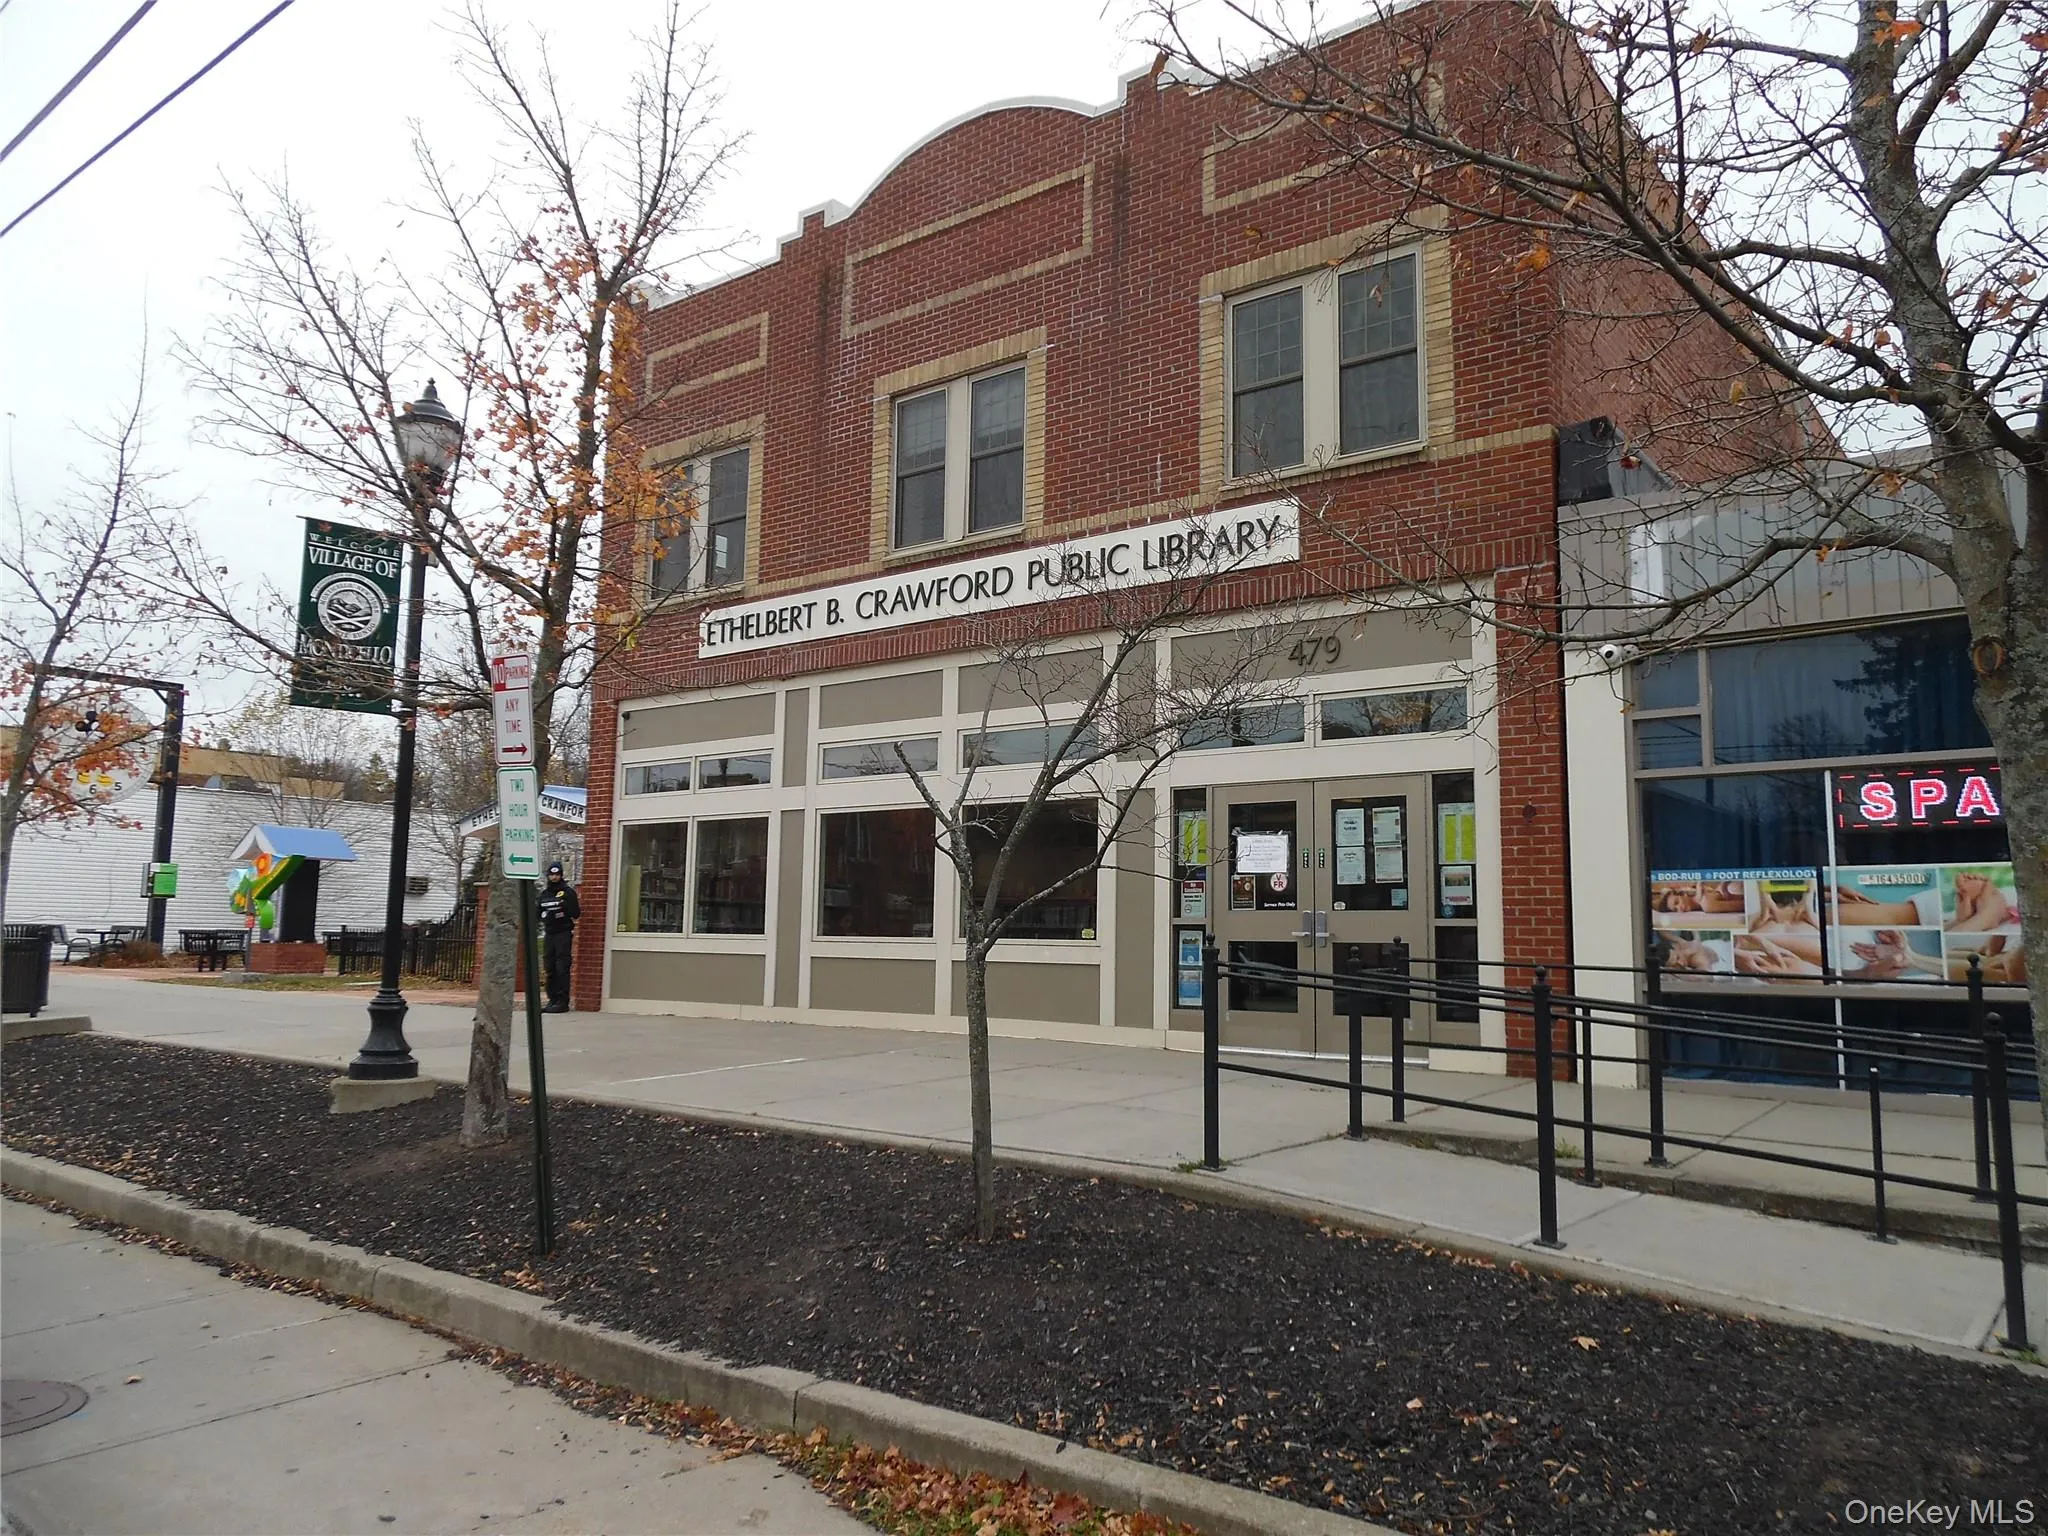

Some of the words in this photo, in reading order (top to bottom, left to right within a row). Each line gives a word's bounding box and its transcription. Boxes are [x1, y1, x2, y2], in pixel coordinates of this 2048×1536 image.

[309, 532, 400, 557] WELCOME
[308, 547, 373, 572] VILLAGE
[375, 560, 398, 578] OF
[706, 600, 818, 646] ETHELBERT
[826, 597, 845, 626] B.
[856, 565, 1014, 620] CRAWFORD
[1027, 543, 1130, 590] PUBLIC
[1142, 514, 1281, 571] LIBRARY
[1288, 636, 1341, 666] 479
[493, 664, 505, 684] NO
[504, 665, 529, 679] PARKING
[504, 698, 519, 712] ANY
[505, 720, 522, 733] TIME
[89, 785, 97, 795] 6
[114, 782, 122, 791] 5
[510, 779, 525, 793] TWO
[1860, 776, 2000, 821] SPA
[508, 803, 529, 817] HOUR
[541, 797, 585, 819] CRAWFOR
[505, 829, 534, 842] PARKING
[1276, 873, 1282, 881] V
[1658, 872, 1702, 881] BOD-RUB
[1713, 871, 1740, 880] FOOT
[1742, 869, 1817, 879] REFLEXOLOGY
[1273, 880, 1284, 889] FR
